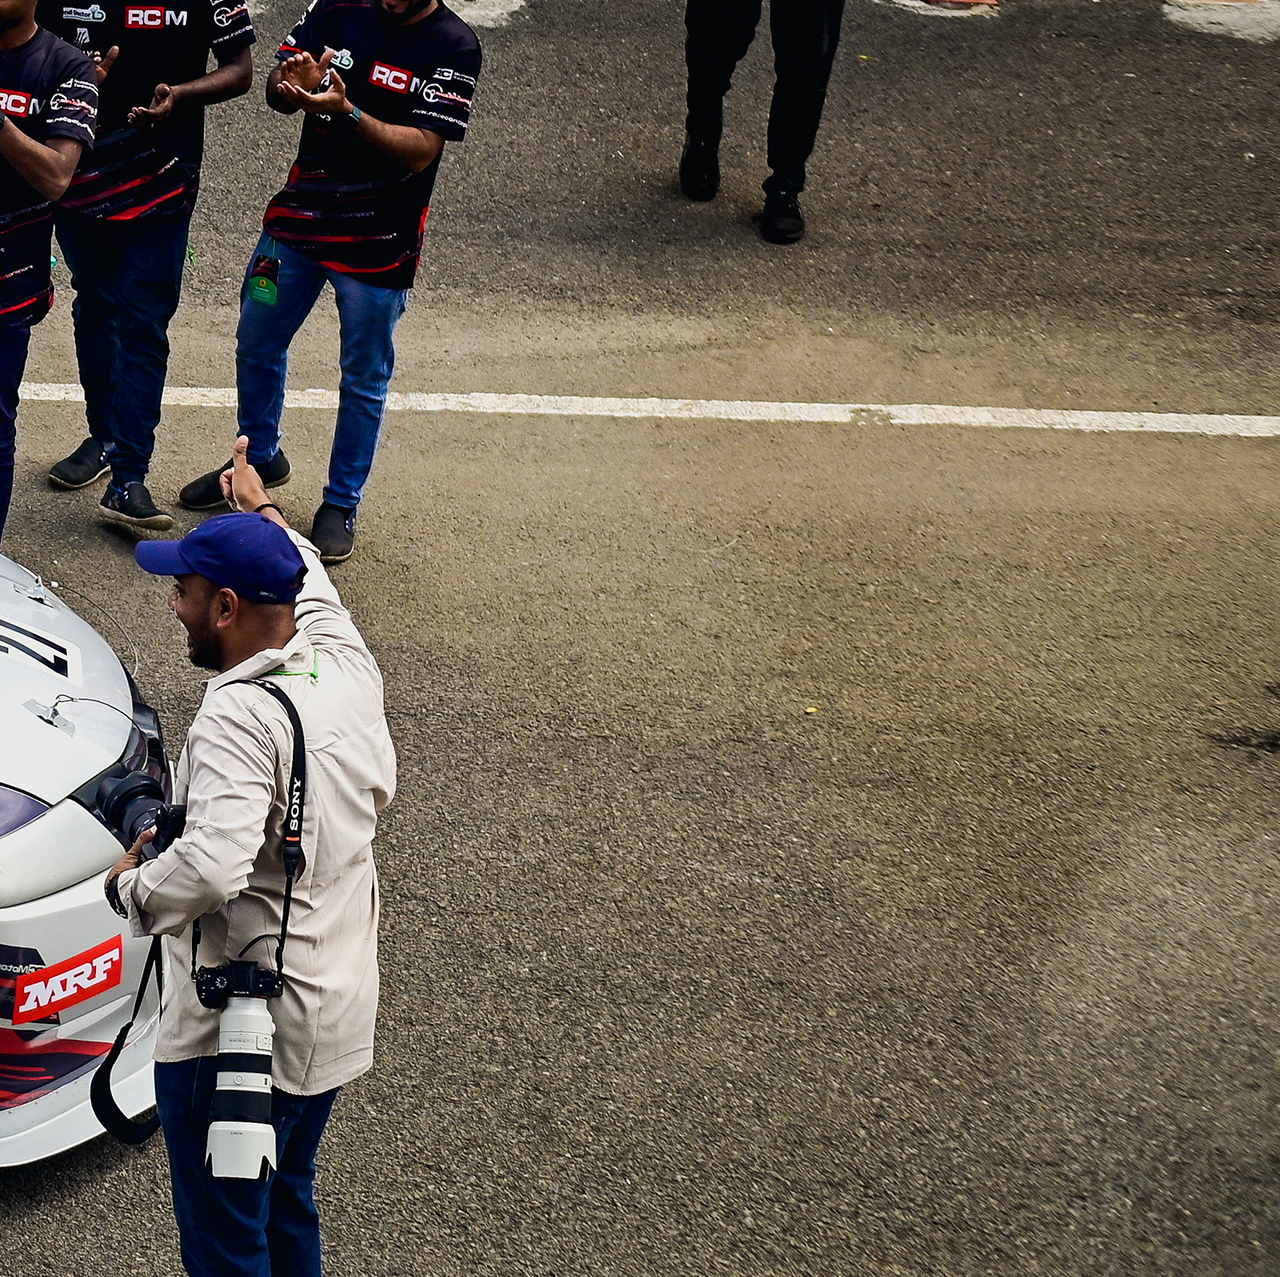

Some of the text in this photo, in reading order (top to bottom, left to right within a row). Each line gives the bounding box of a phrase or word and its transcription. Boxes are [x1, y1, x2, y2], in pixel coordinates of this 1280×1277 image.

[127, 10, 188, 26] RCM
[290, 776, 302, 832] SONY
[18, 947, 120, 1014] MRF
